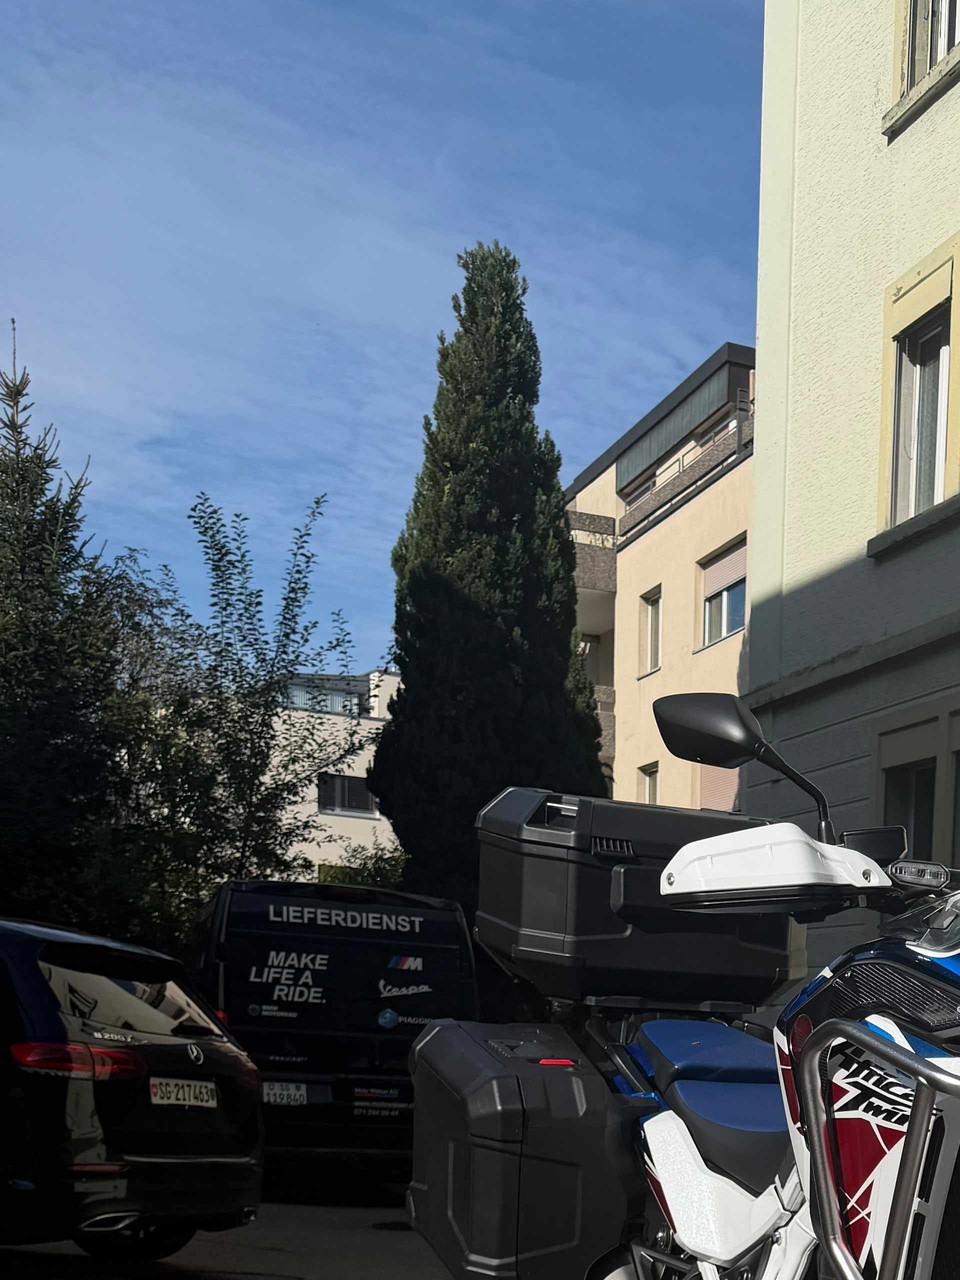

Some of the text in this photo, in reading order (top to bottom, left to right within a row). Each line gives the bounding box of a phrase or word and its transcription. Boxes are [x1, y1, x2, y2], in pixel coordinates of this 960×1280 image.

[269, 904, 424, 933] LIEFERDIENST
[267, 951, 329, 970] MAKE
[249, 966, 314, 986] LIFE A
[273, 985, 327, 1003] RIDE.
[379, 979, 432, 998] Vespa
[827, 1040, 915, 1101] Afric
